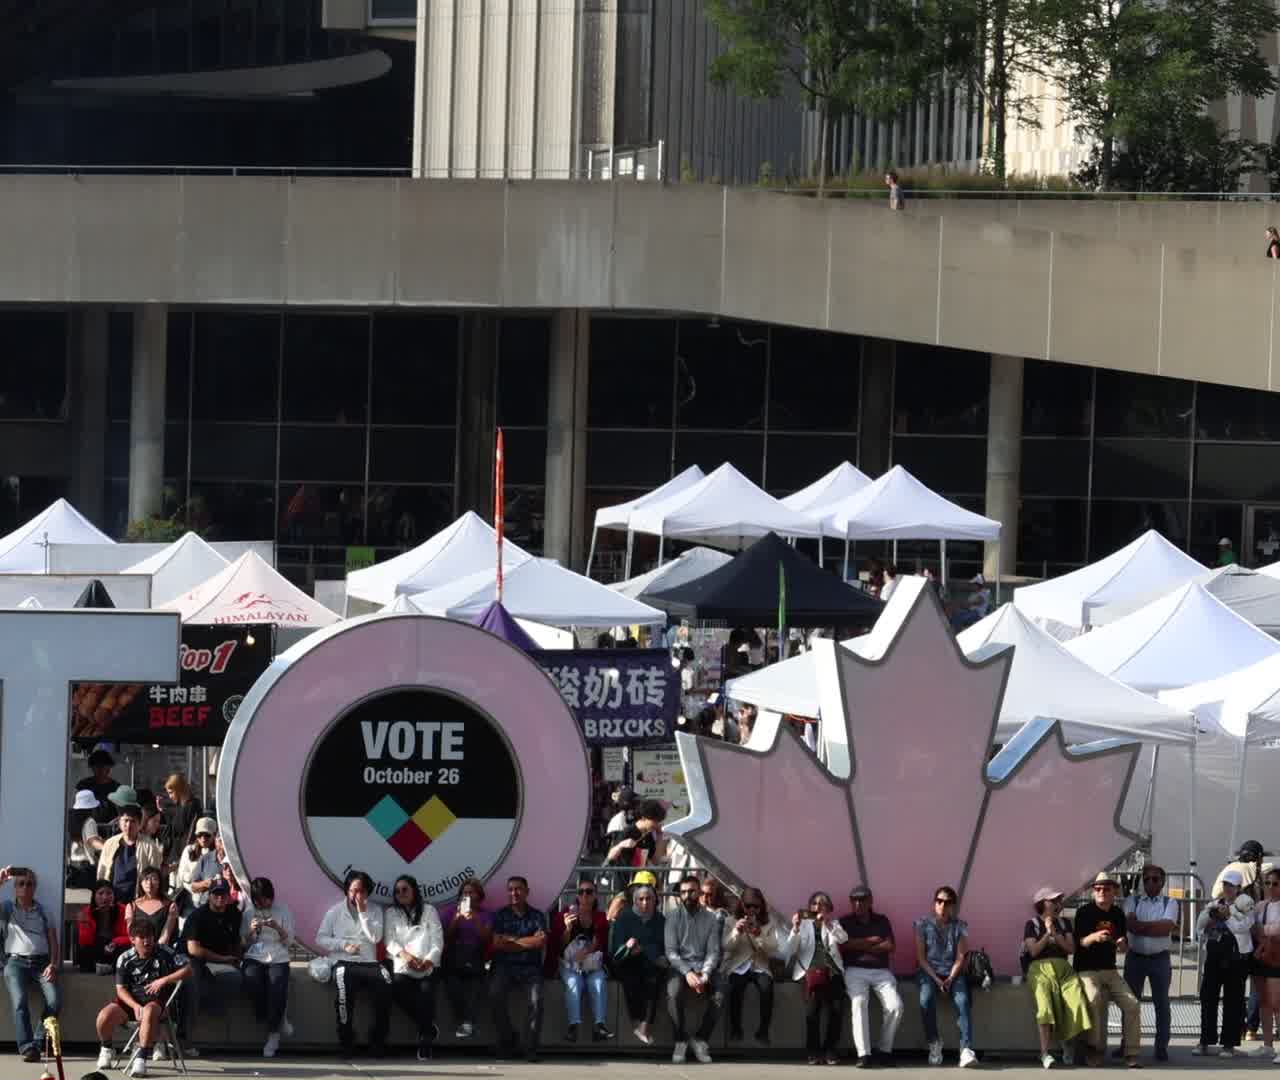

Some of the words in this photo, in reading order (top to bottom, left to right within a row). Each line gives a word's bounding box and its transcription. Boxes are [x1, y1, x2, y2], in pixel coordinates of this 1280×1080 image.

[214, 611, 310, 625] HIMALAYAN
[209, 640, 237, 673] 1
[149, 684, 207, 703] 牛肉串
[149, 706, 211, 728] BEEF
[584, 719, 665, 738] BRICKS
[361, 721, 464, 760] VOTE
[364, 767, 432, 784] October
[438, 767, 460, 784] 26
